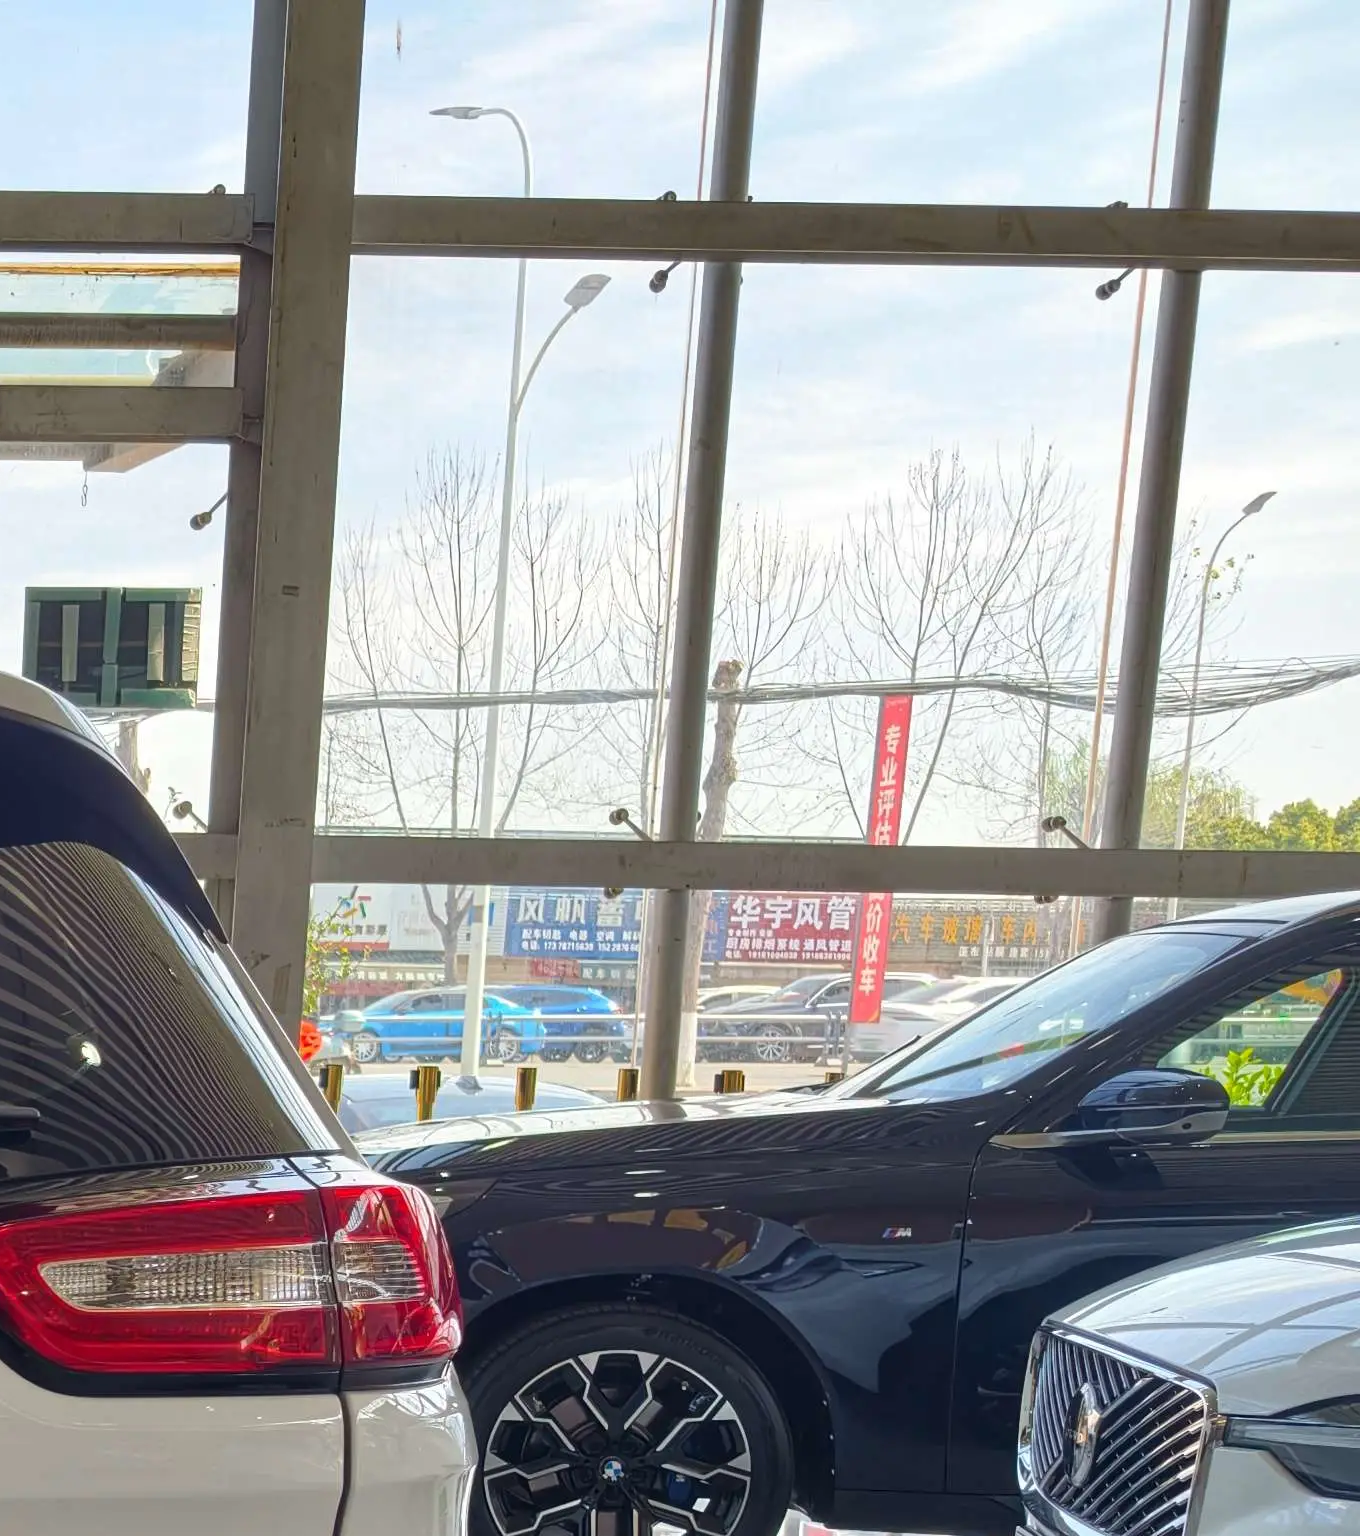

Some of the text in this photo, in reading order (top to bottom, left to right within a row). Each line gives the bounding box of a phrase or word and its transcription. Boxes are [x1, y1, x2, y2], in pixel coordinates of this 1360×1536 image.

[730, 895, 857, 930] 华宇风管
[803, 939, 852, 952] 通风管道
[858, 893, 885, 996] 价收车
